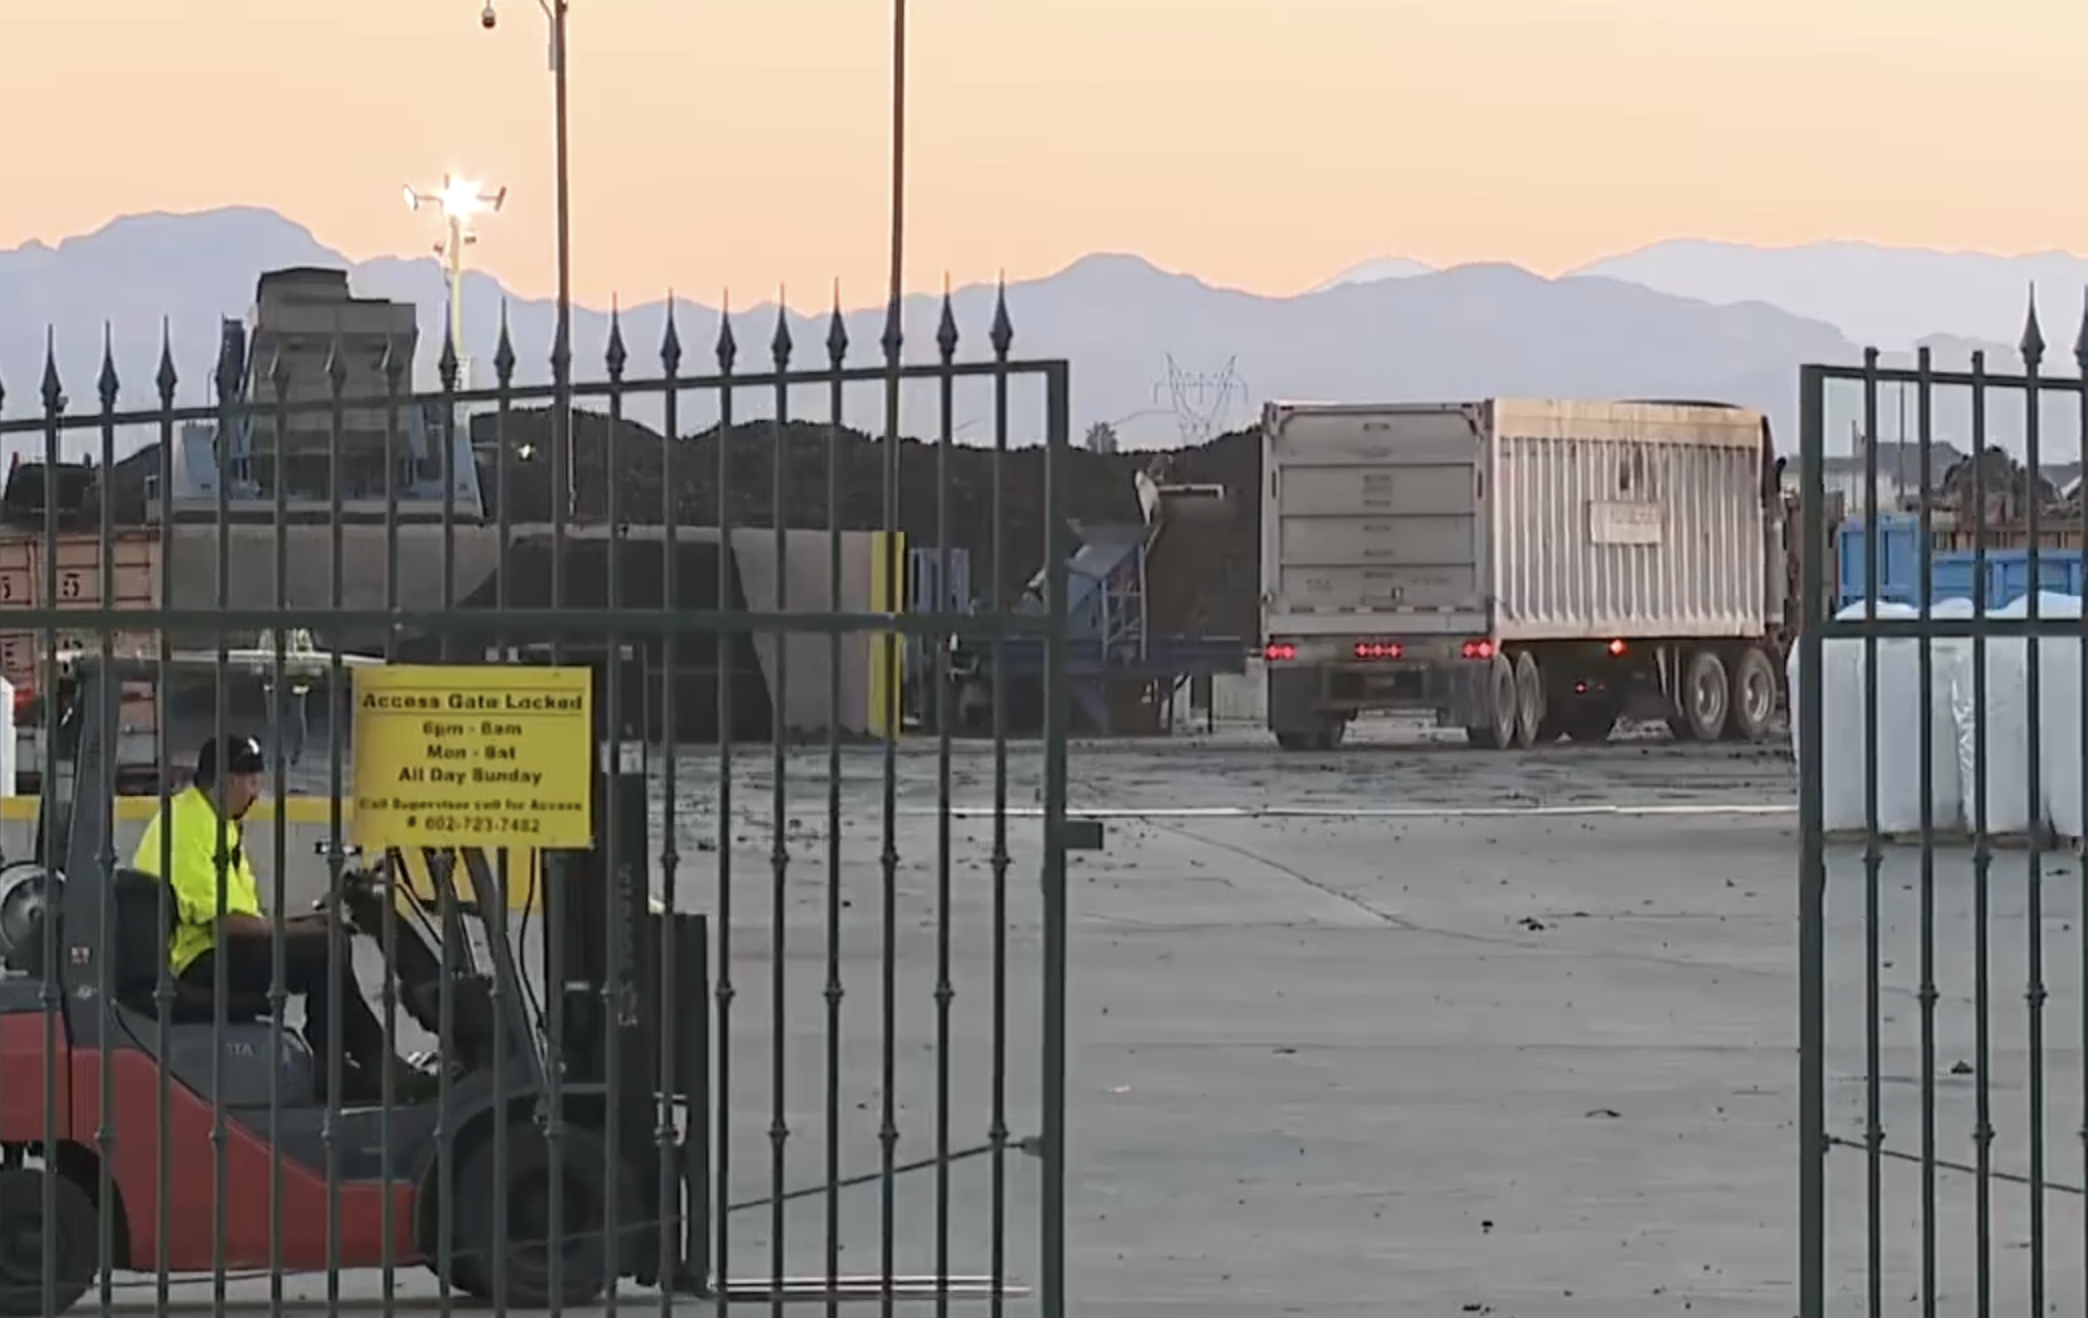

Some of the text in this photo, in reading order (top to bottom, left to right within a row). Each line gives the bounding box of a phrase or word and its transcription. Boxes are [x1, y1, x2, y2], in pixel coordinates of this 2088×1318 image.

[363, 693, 583, 710] Access Gate Locked
[427, 744, 466, 759] Mon
[484, 745, 515, 760] Sat
[398, 767, 542, 786] All Day Sunday
